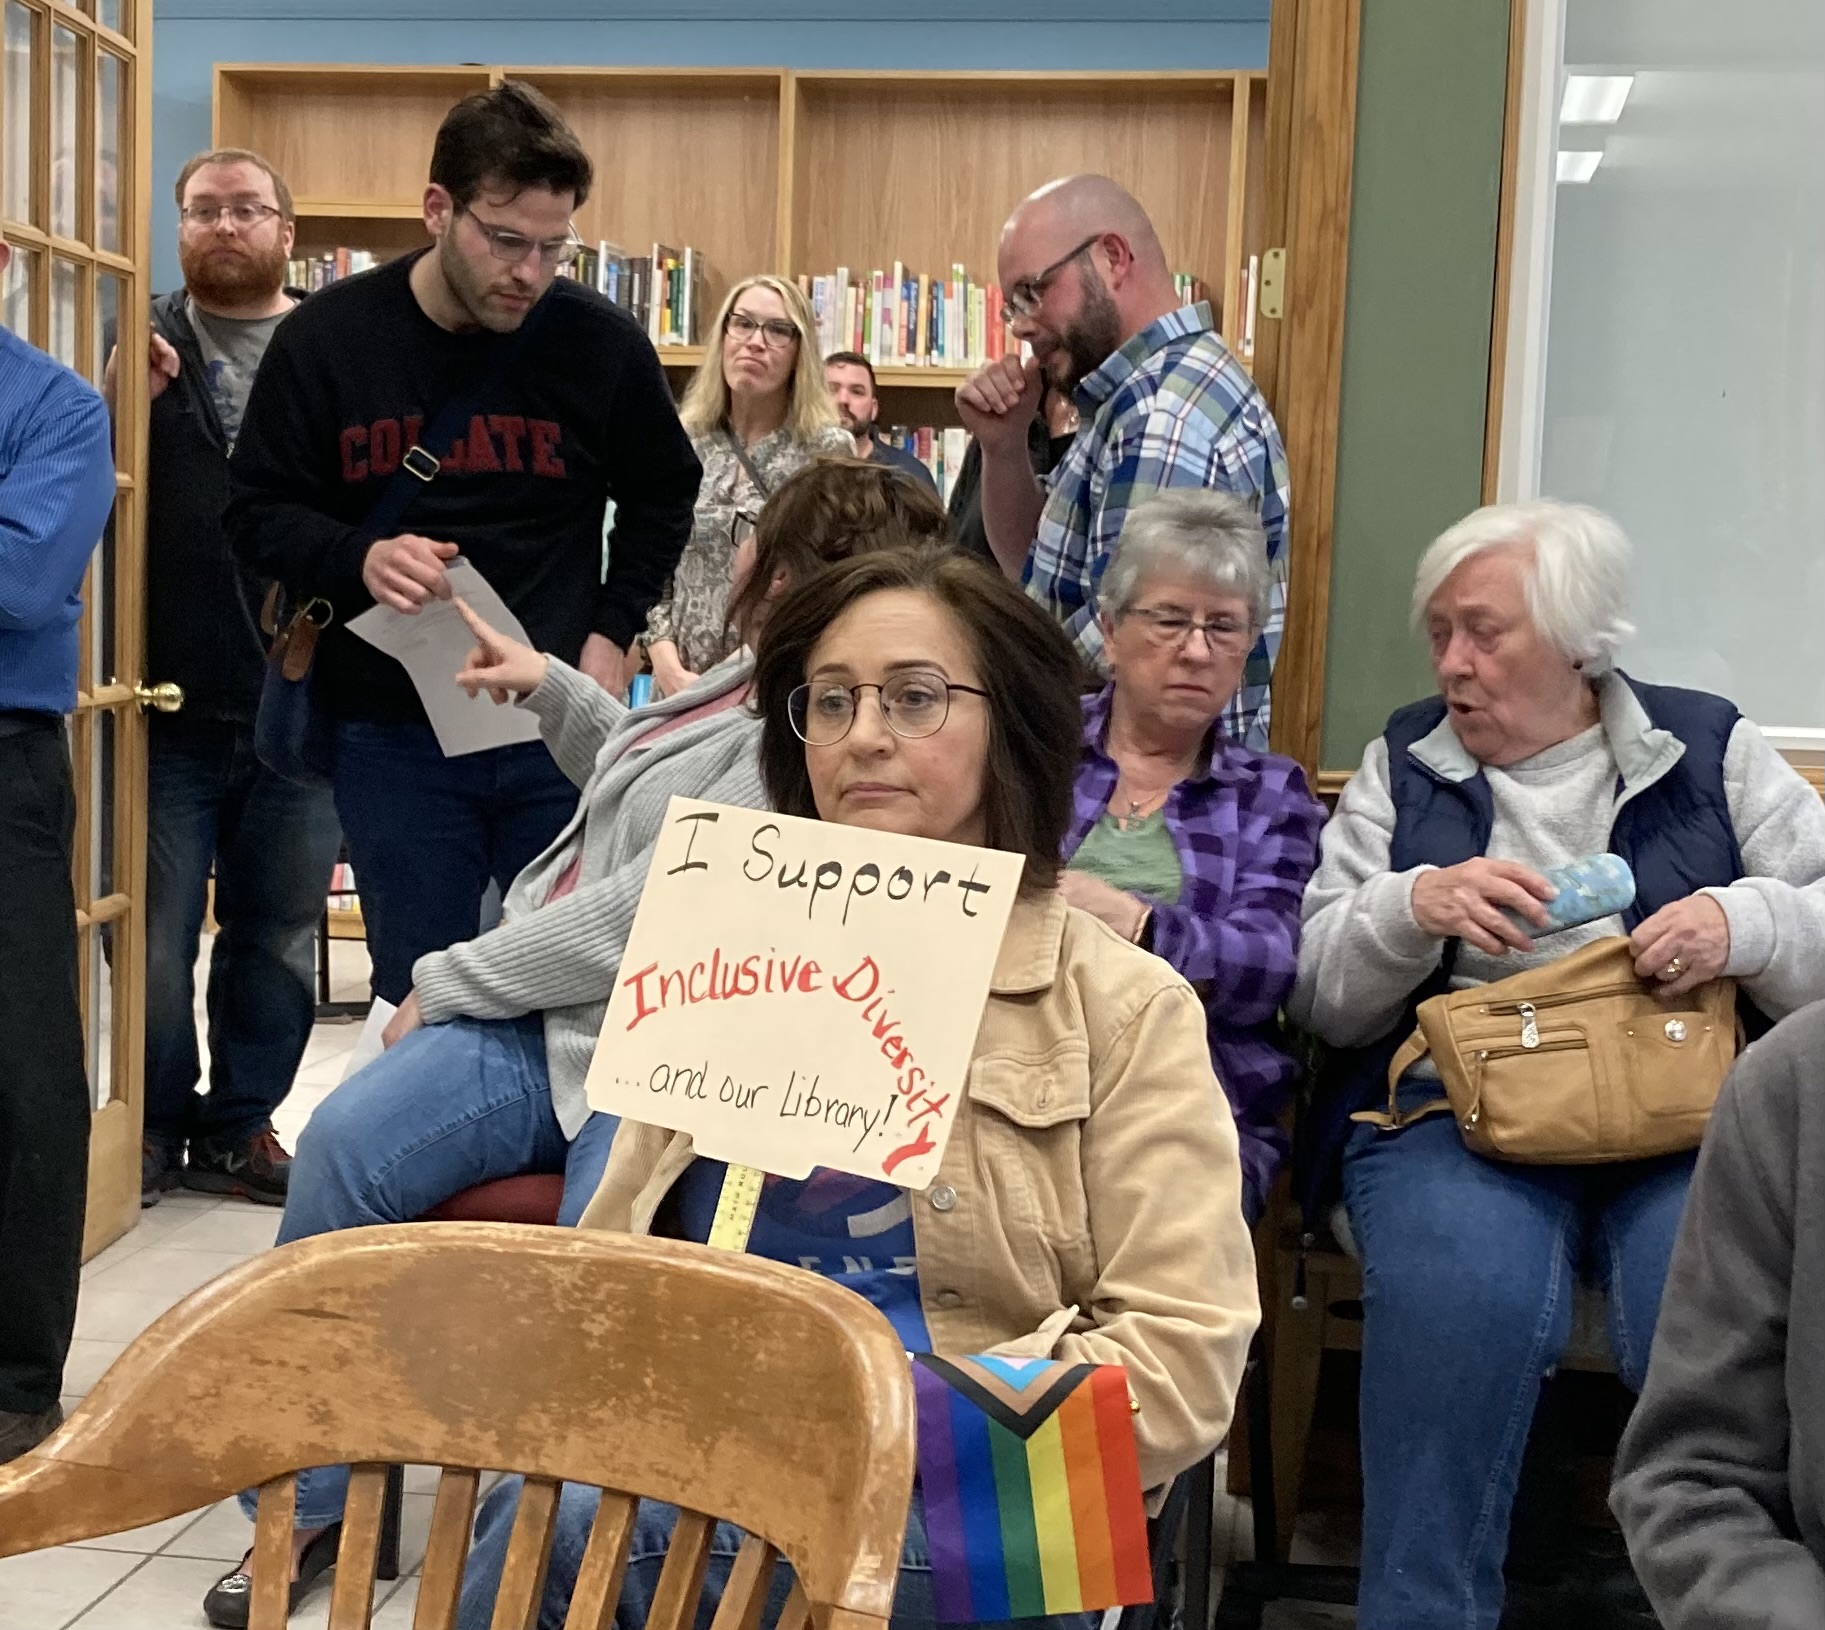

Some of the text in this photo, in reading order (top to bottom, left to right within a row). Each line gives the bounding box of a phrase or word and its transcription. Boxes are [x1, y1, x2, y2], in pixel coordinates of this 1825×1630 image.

[667, 812, 991, 925] I Support
[623, 947, 951, 1177] Inclusive Diversity
[719, 1075, 769, 1109] our
[779, 1070, 899, 1153] Library!
